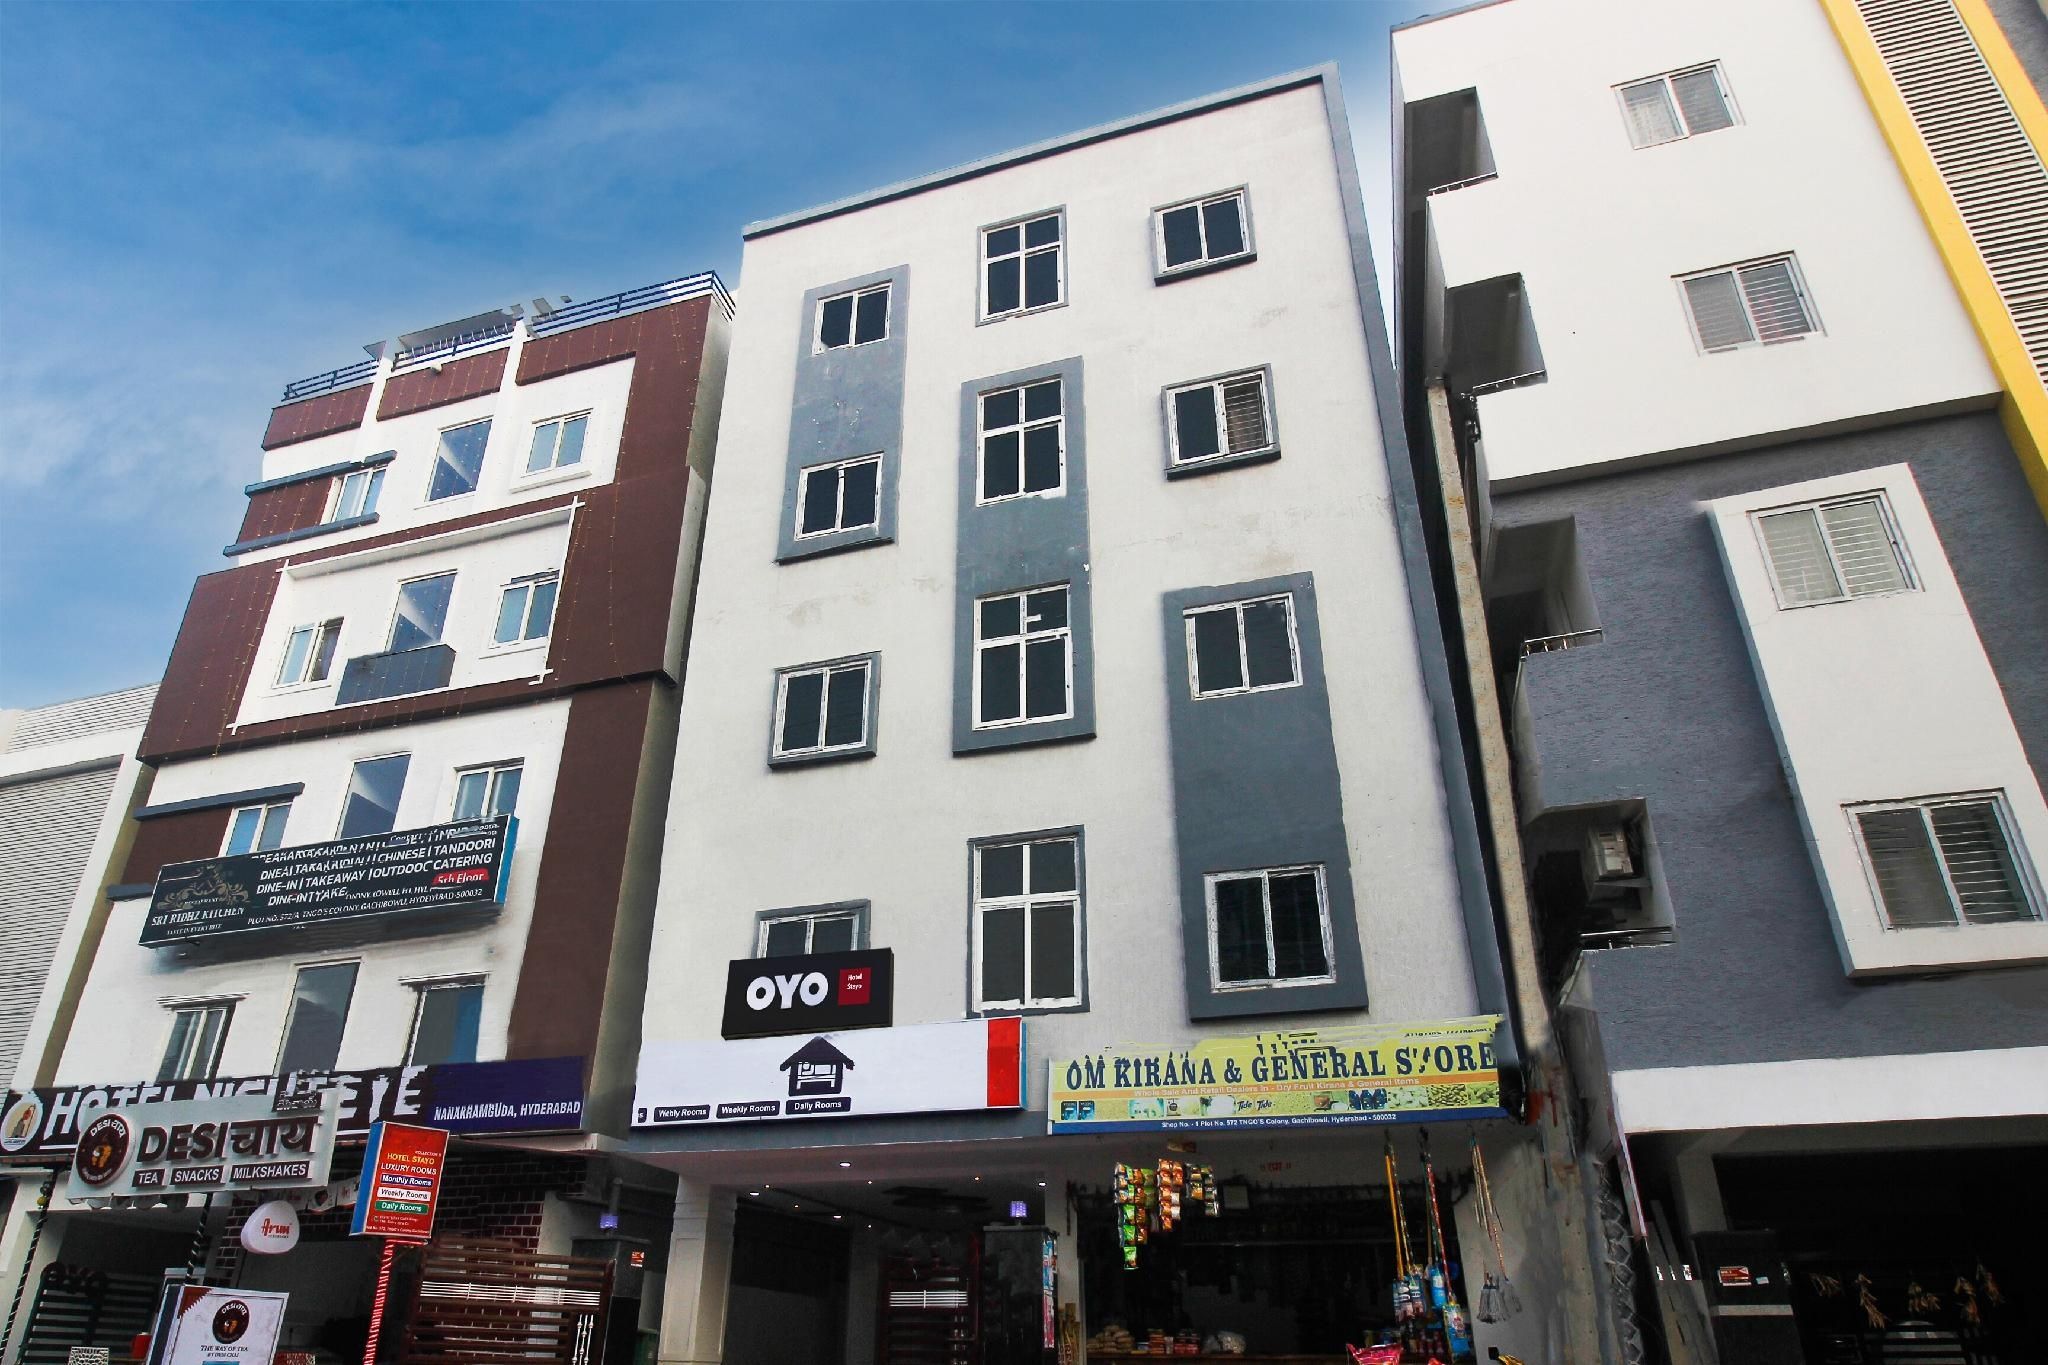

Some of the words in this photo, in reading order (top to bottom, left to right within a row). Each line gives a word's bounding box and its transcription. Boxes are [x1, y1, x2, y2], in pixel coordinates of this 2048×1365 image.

[434, 838, 496, 856] TANDOORI
[256, 880, 298, 895] DINE-IN
[305, 869, 366, 888] TAKEAWAY
[433, 853, 493, 871] CATERING
[746, 971, 829, 1011] OYO
[1066, 1055, 1106, 1090] OM
[1114, 1054, 1216, 1088] KIRANA
[1223, 1057, 1242, 1083] &
[1251, 1046, 1386, 1082] GENERAL
[1135, 1088, 1160, 1097] Whole
[1200, 1086, 1223, 1094] Retail
[1226, 1085, 1258, 1093] Dealers
[1293, 1082, 1314, 1090] Fruit
[1316, 1081, 1346, 1089] Kirana
[1358, 1079, 1392, 1087] General
[1395, 1077, 1420, 1086] Items
[520, 1101, 581, 1116] HYDERABAD
[749, 1104, 776, 1113] Rooms
[794, 1101, 813, 1111] Daily
[814, 1100, 842, 1110] Rooms
[681, 1108, 707, 1117] Rooms
[1331, 1114, 1367, 1123] Hyderabad
[90, 1119, 111, 1137] DESI
[387, 1153, 410, 1162] HOTEL
[412, 1155, 435, 1165] STAYO
[174, 1167, 220, 1183] SNACKS
[233, 1163, 307, 1180] MILKSHAKES
[380, 1163, 410, 1172] LUXURY
[410, 1165, 437, 1175] ROOMS
[138, 1172, 158, 1185] TEA
[382, 1175, 409, 1186] Monthly
[409, 1177, 432, 1186] Rooms
[381, 1188, 405, 1198] Weekly
[405, 1190, 428, 1200] Rooms
[381, 1201, 399, 1211] Daily
[398, 1203, 422, 1212] Rooms
